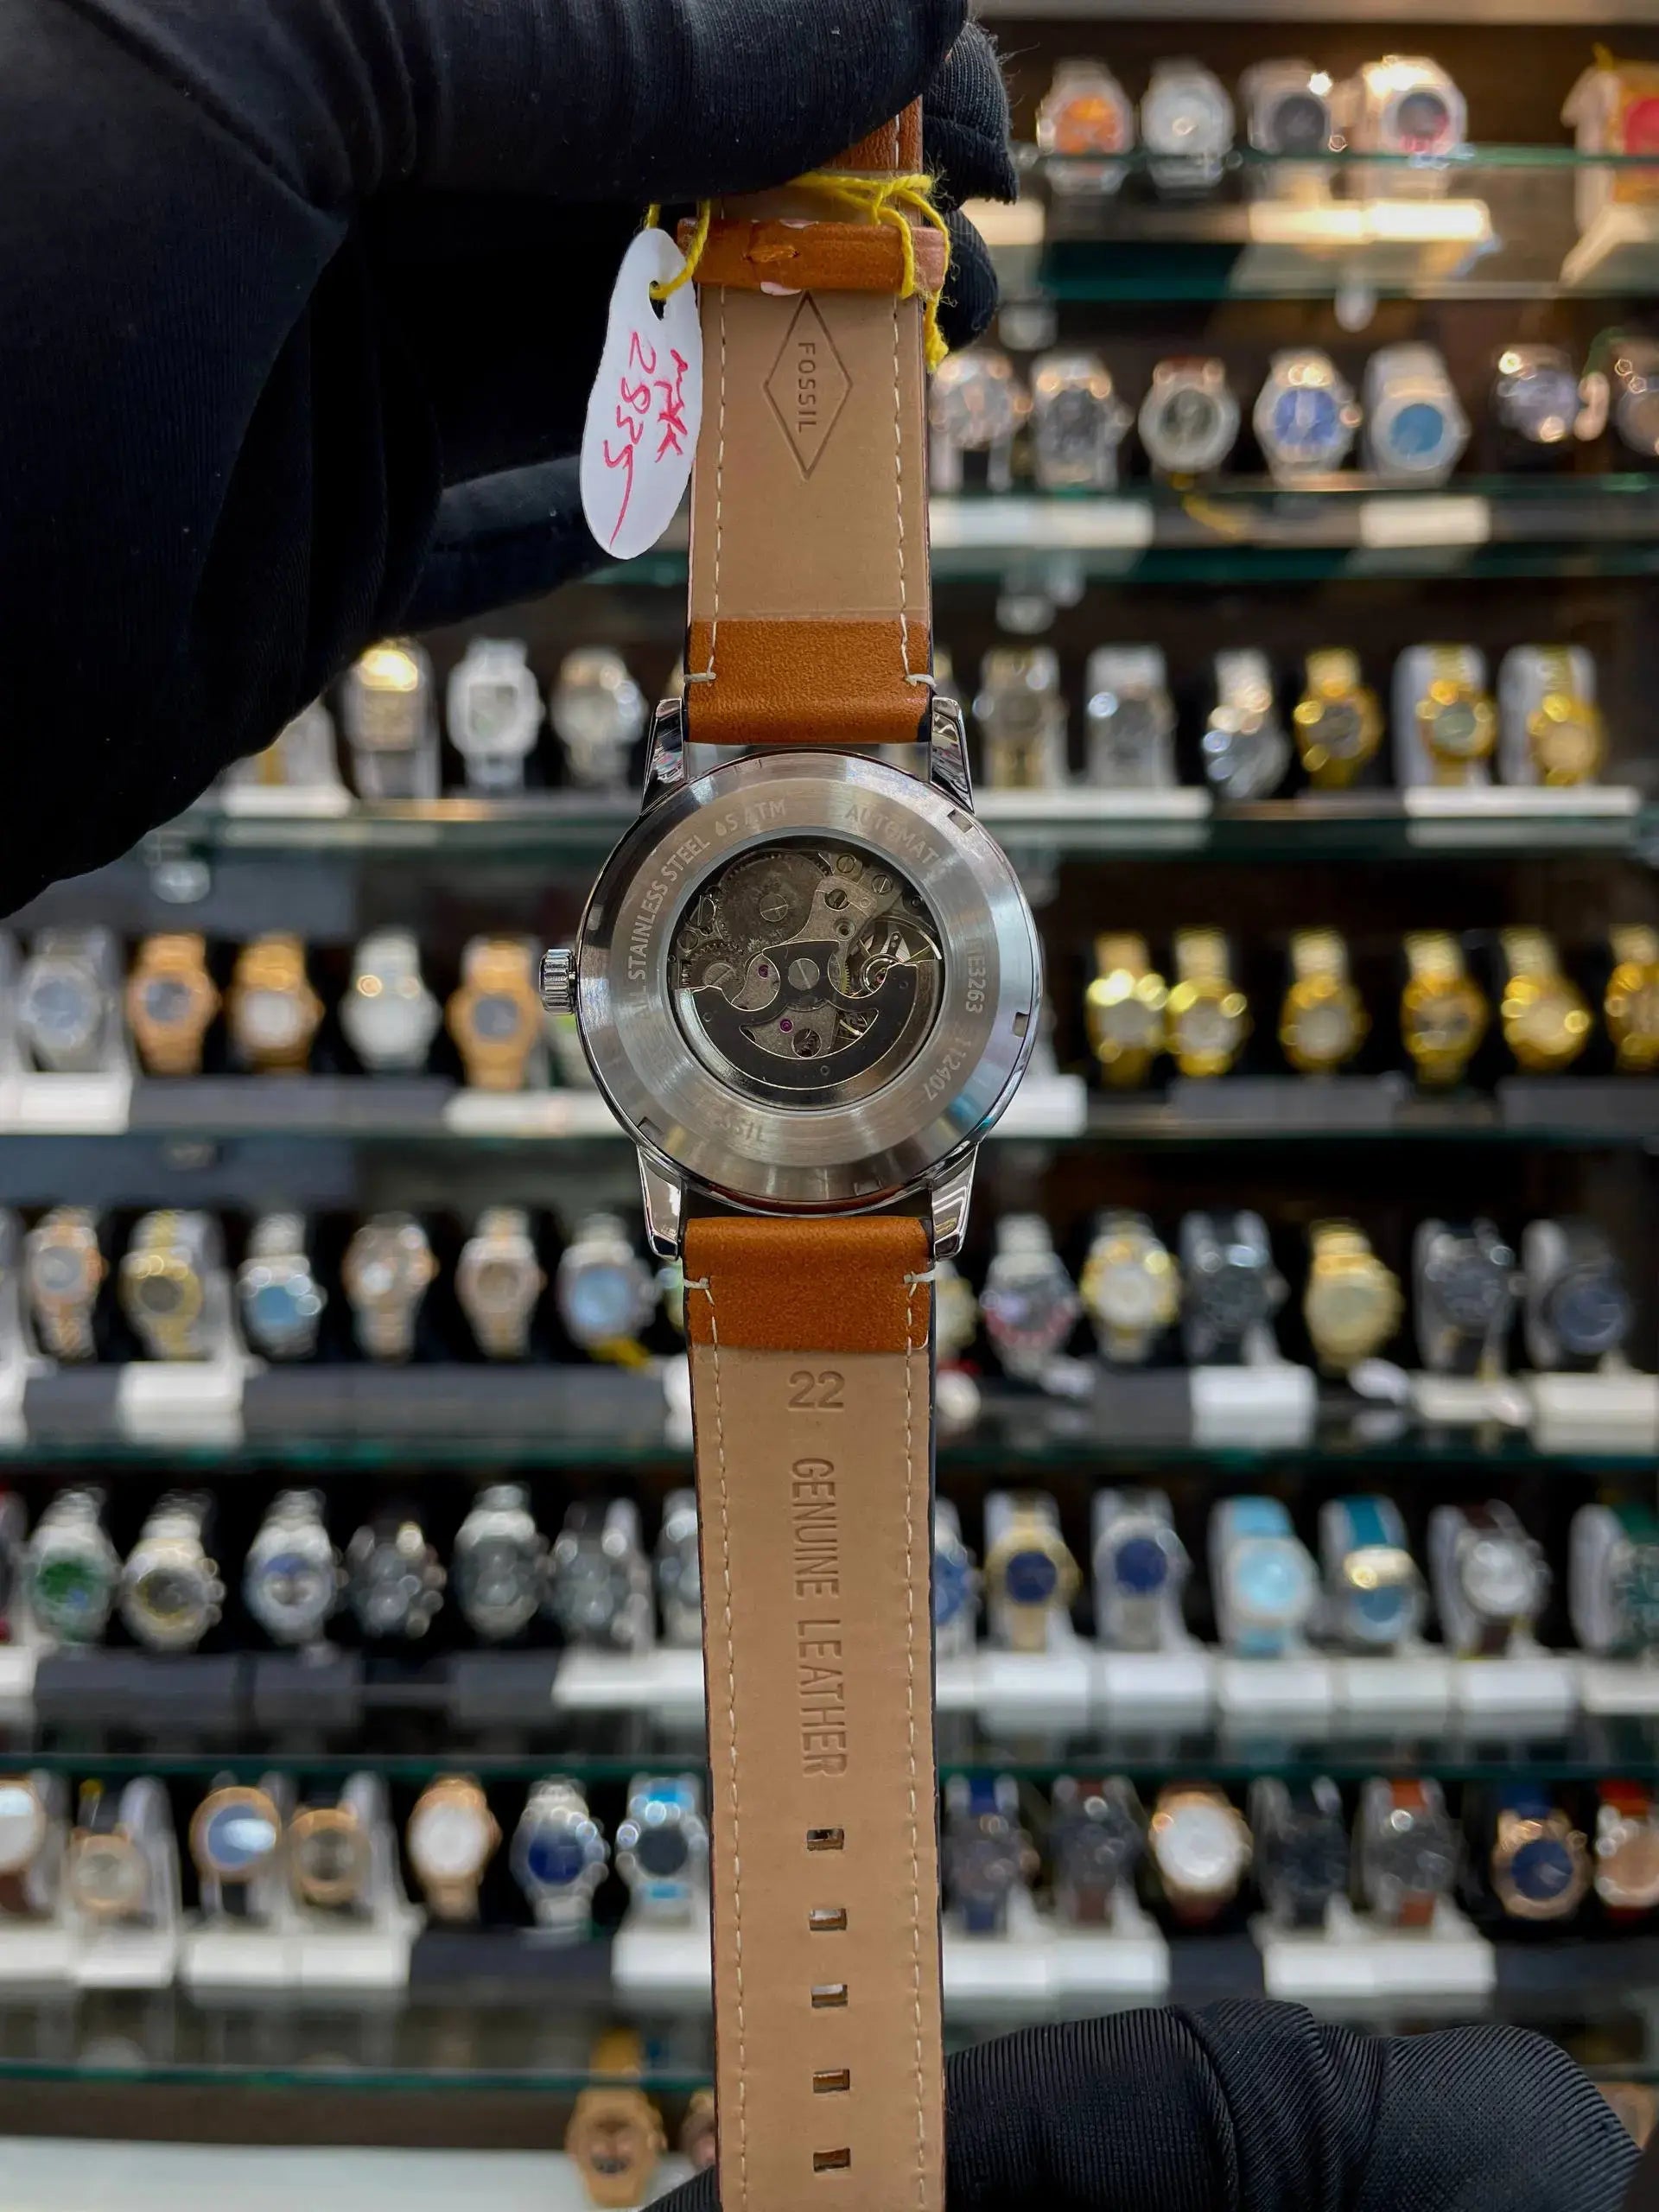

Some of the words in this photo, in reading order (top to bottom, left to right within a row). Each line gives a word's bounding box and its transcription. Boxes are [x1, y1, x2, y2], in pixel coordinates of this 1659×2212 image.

[797, 342, 817, 433] FOSSIL
[628, 880, 668, 980] STAINLESS
[661, 835, 711, 881] STEEL
[745, 798, 786, 826] ATM
[787, 1370, 846, 1411] 22
[791, 1457, 840, 1599] GENUINE
[796, 1619, 848, 1777] LEATHER
